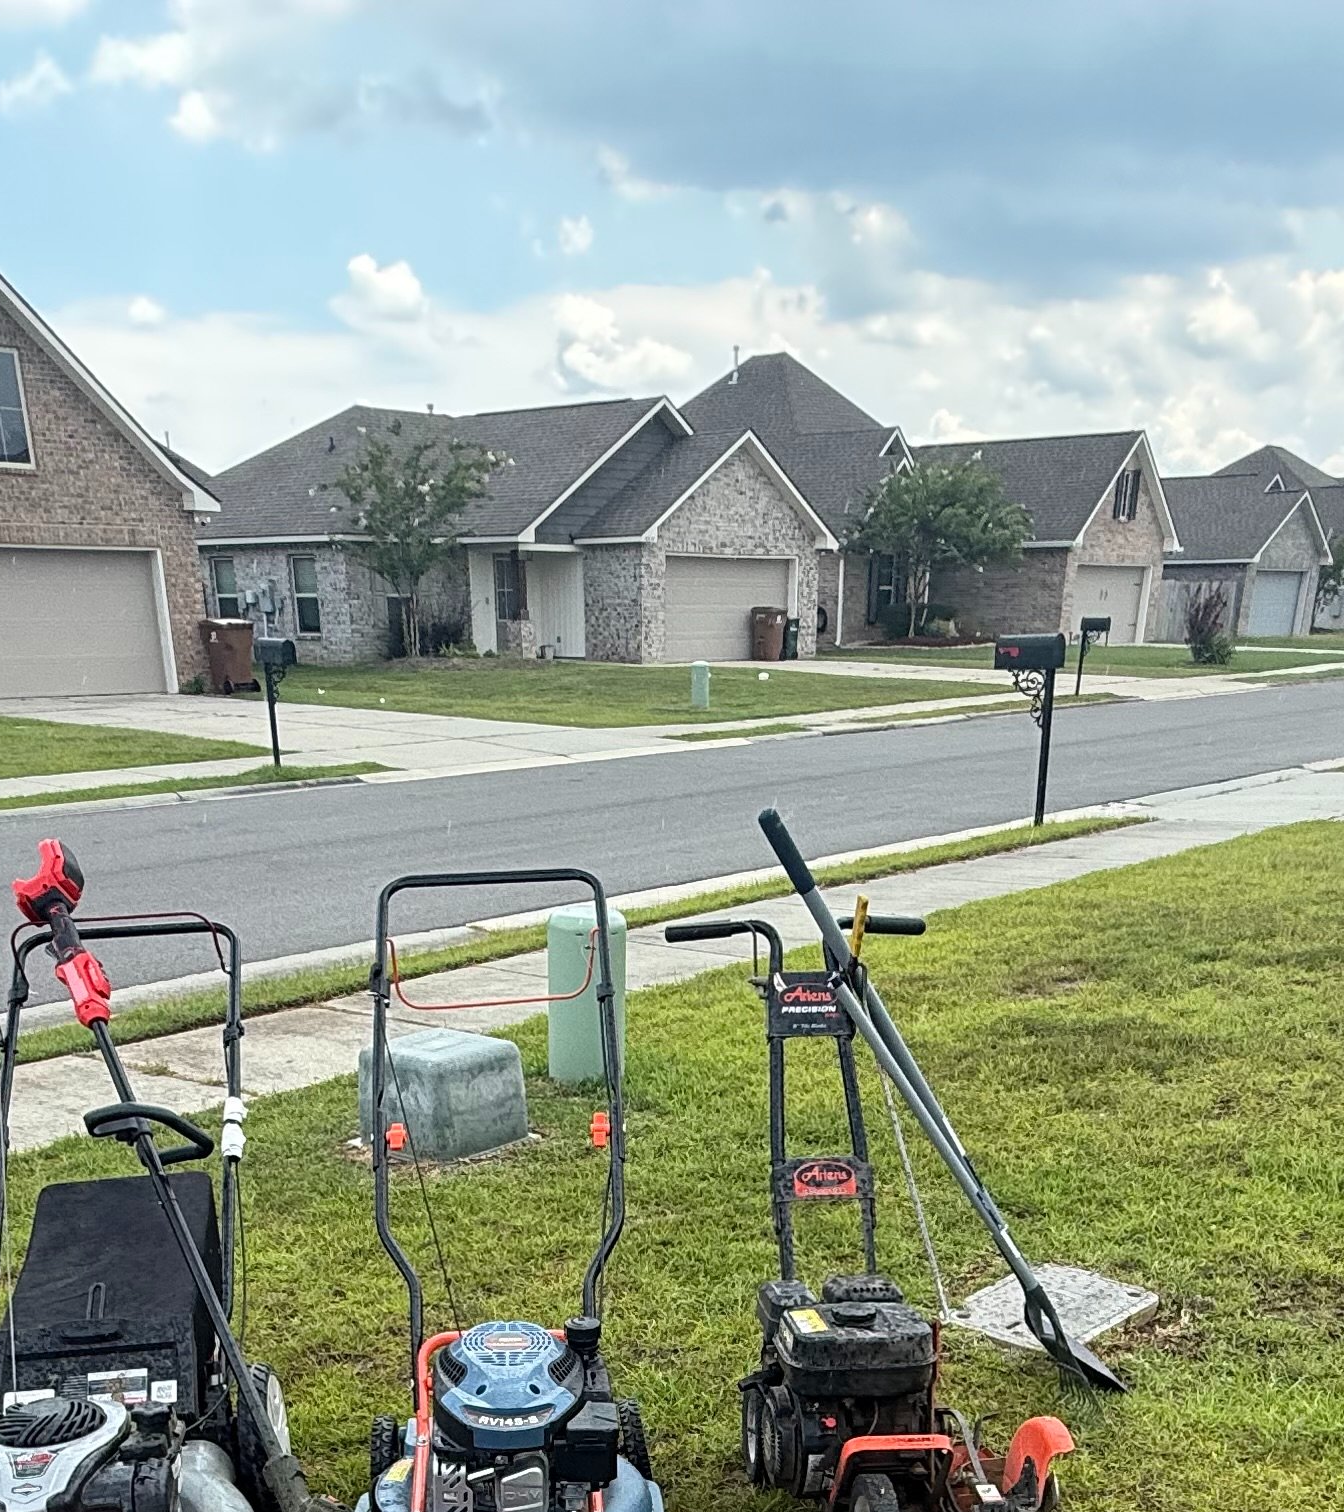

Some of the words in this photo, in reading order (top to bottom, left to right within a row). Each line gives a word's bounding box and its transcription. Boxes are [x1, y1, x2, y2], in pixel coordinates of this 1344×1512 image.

[783, 986, 832, 1002] Ariens
[781, 1005, 837, 1014] PRECISION
[801, 1166, 848, 1182] Ariens
